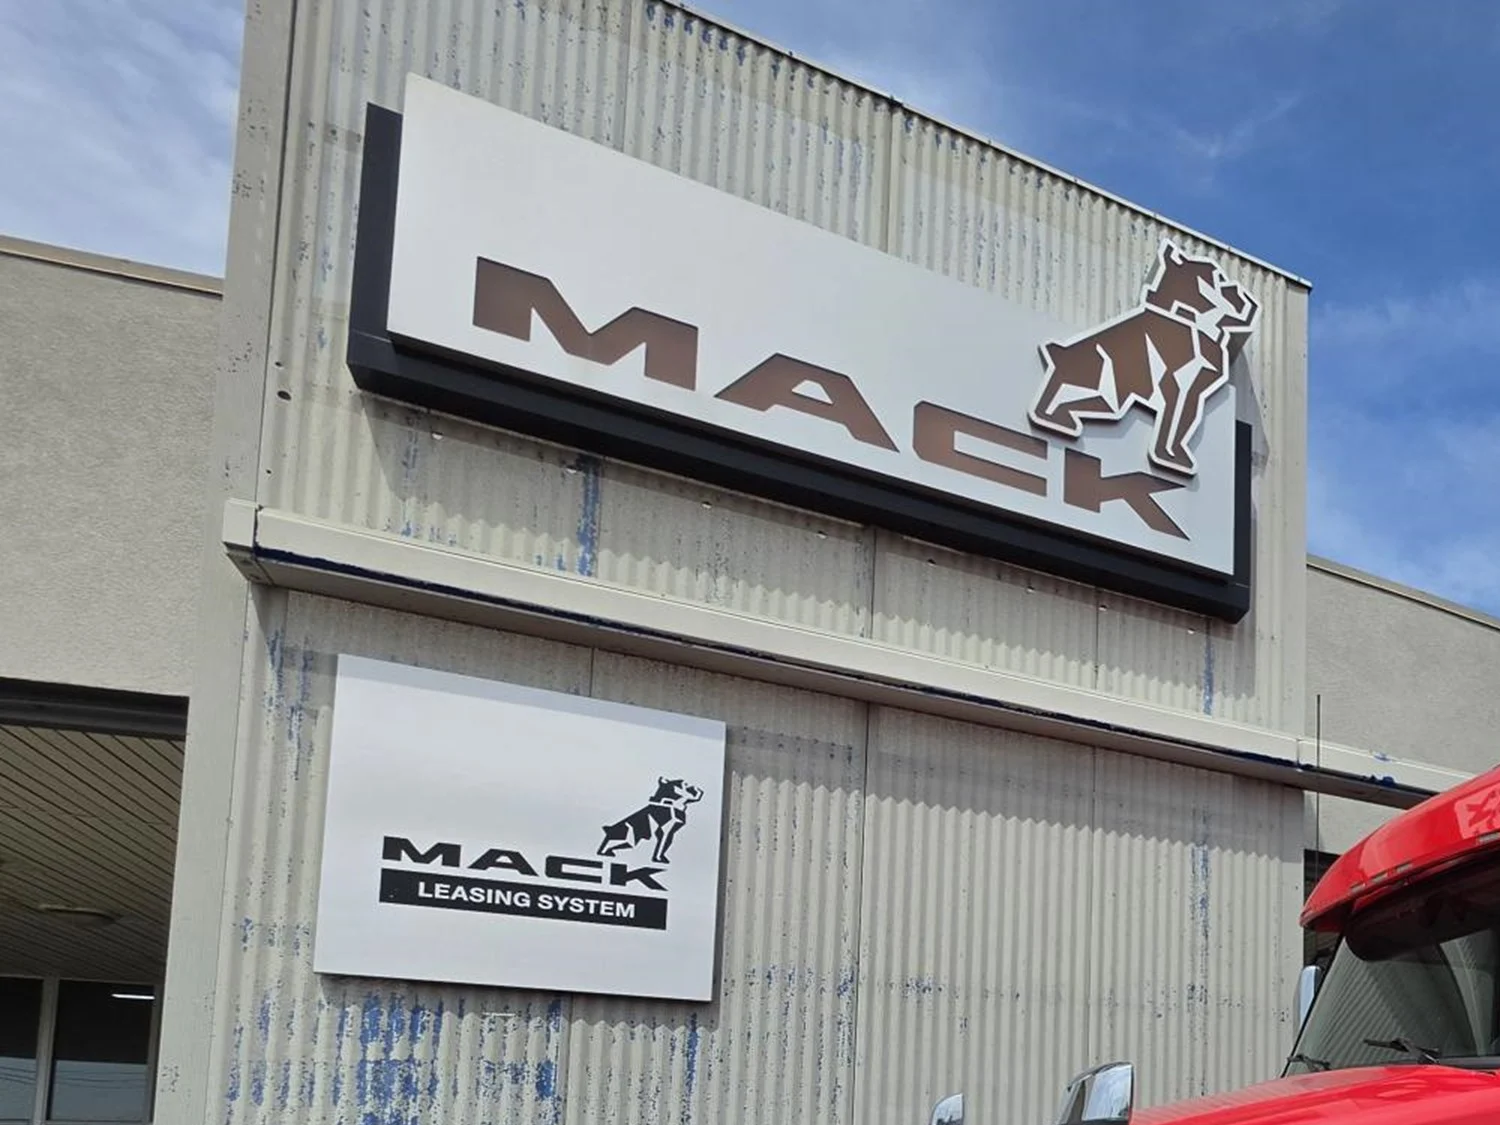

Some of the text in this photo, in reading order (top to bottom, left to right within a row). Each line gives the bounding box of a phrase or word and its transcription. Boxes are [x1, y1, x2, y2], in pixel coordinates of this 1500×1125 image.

[472, 256, 1190, 541] MACK
[382, 835, 669, 891] MACK
[418, 881, 636, 919] LEASING SYSTEM
